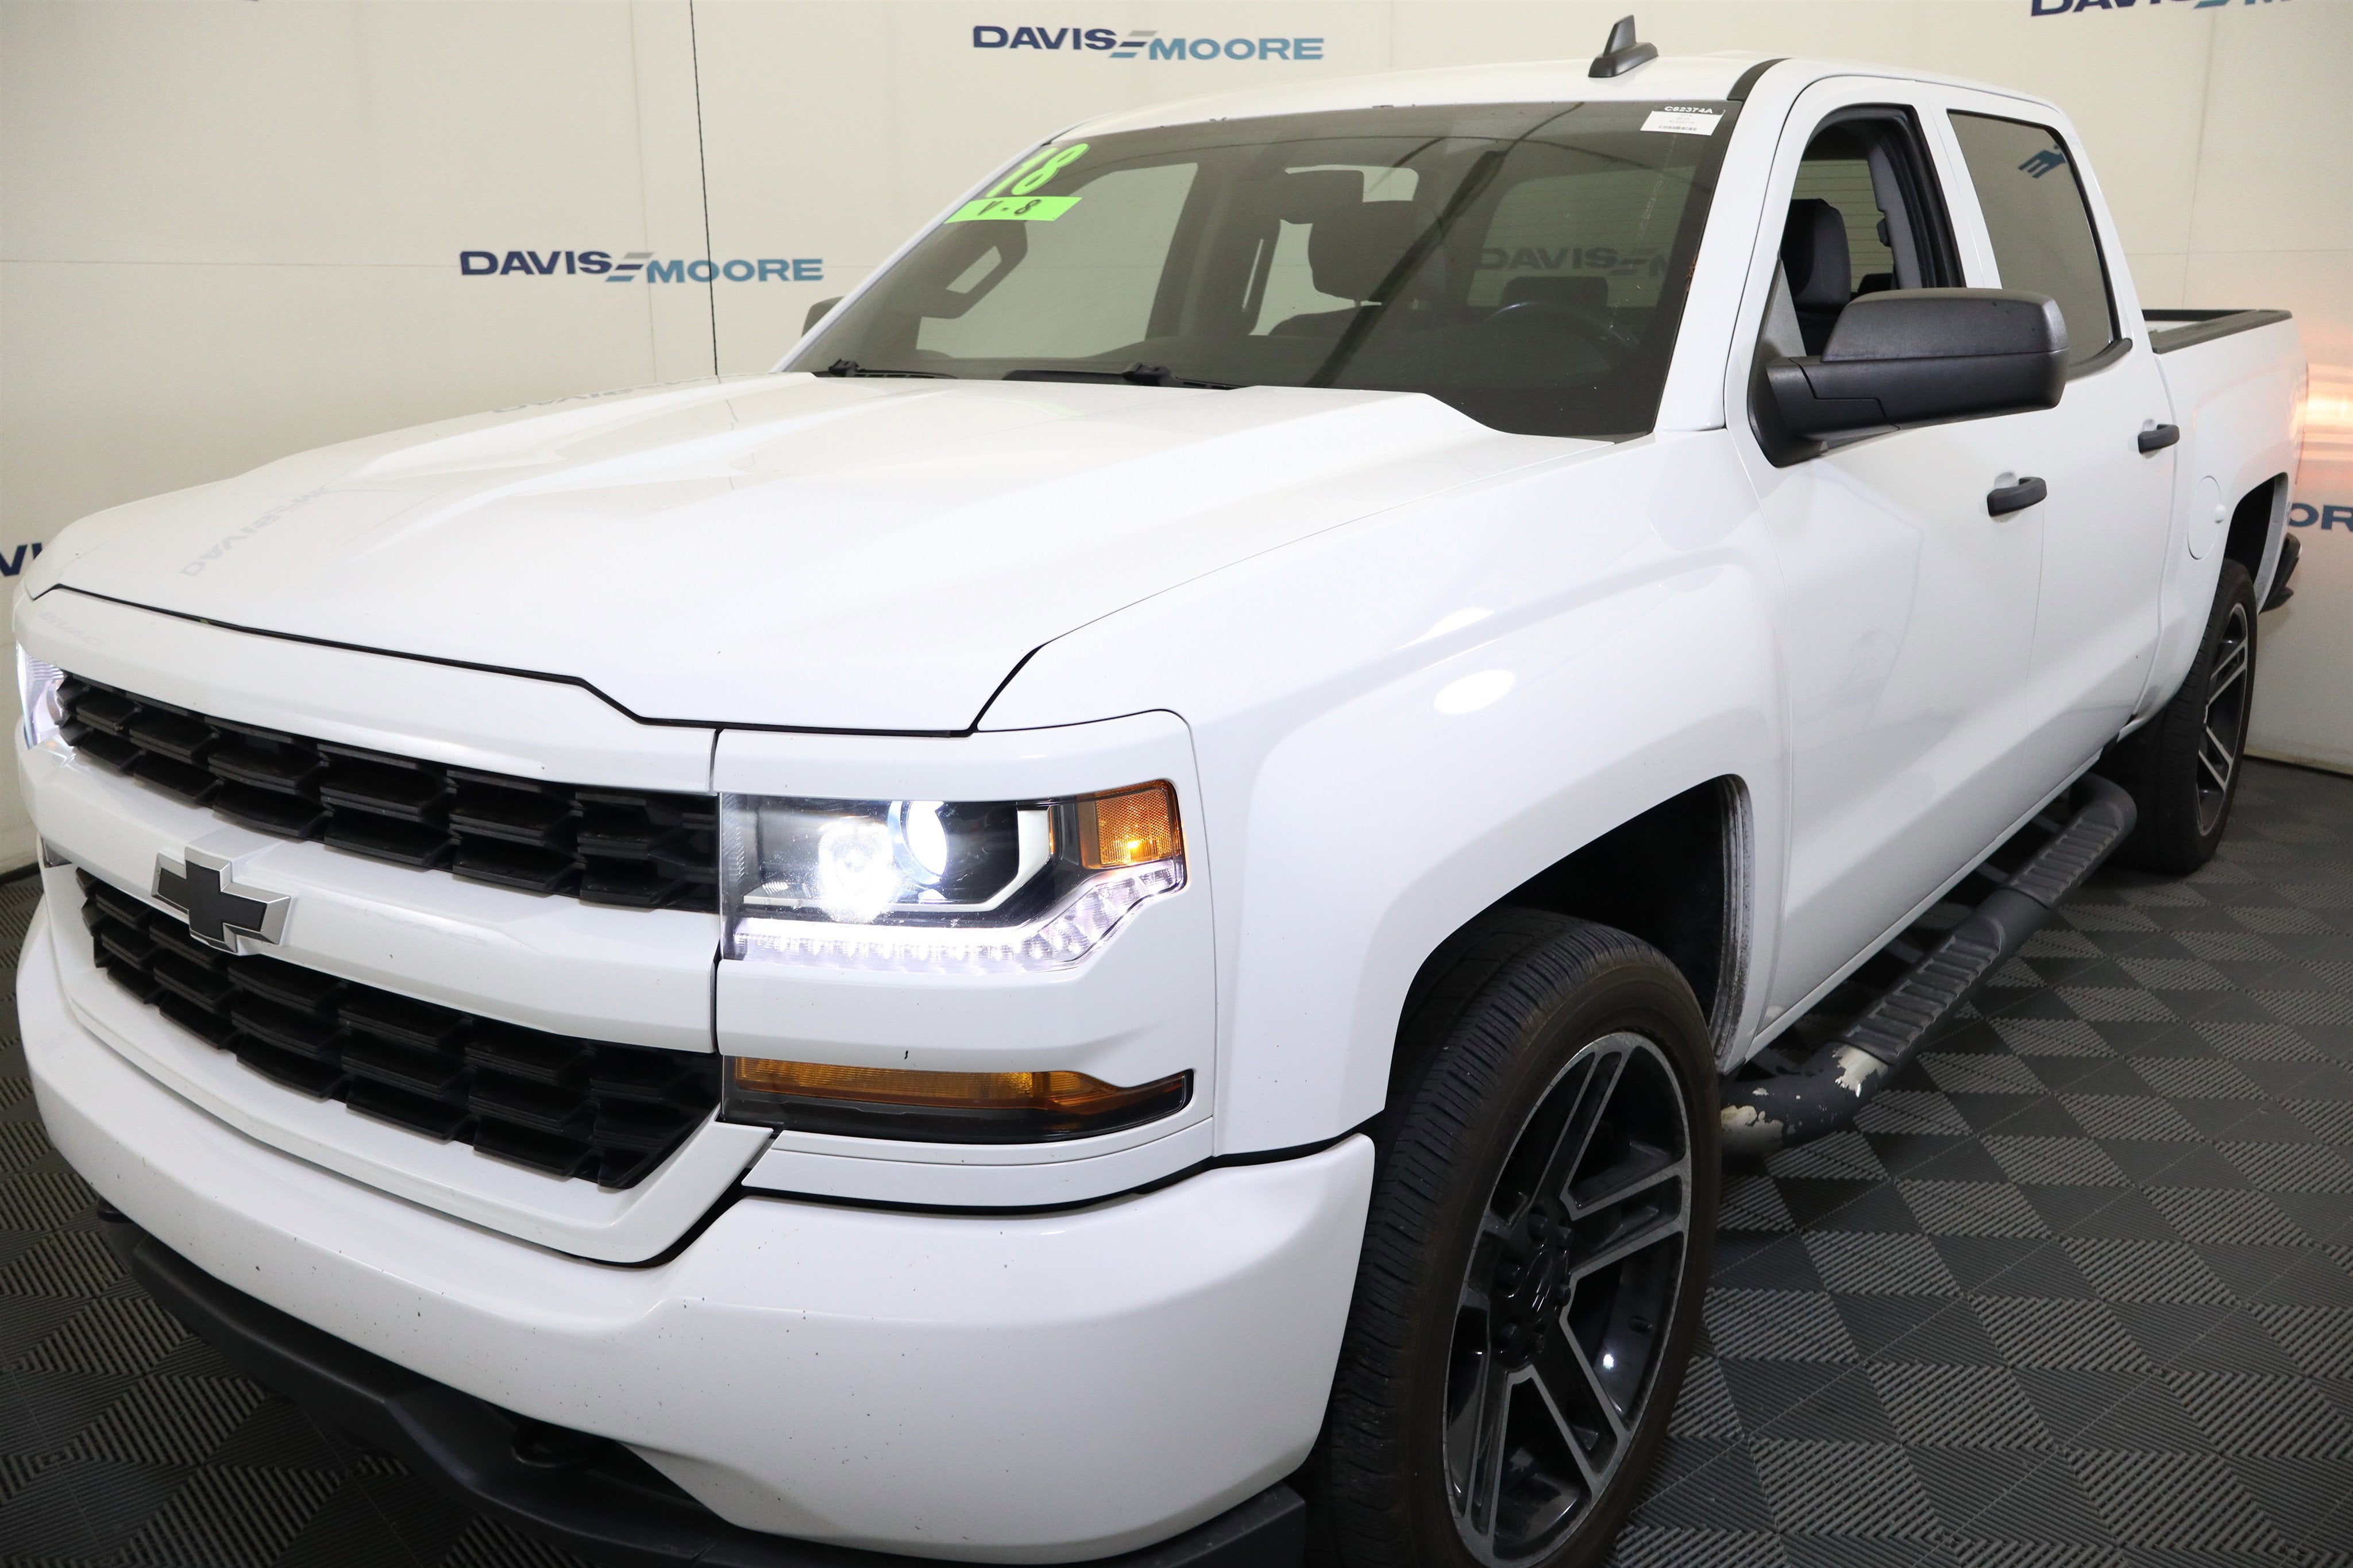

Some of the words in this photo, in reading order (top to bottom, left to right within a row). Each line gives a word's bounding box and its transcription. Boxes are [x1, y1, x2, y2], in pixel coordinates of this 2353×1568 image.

[973, 25, 1117, 50] DAVIS
[1148, 38, 1325, 60] MOORE
[1664, 106, 1714, 114] C82374A
[985, 143, 1089, 198] 18
[460, 251, 612, 276] DAVIS
[646, 258, 824, 283] MOORE
[1478, 247, 1619, 269] DAVIS
